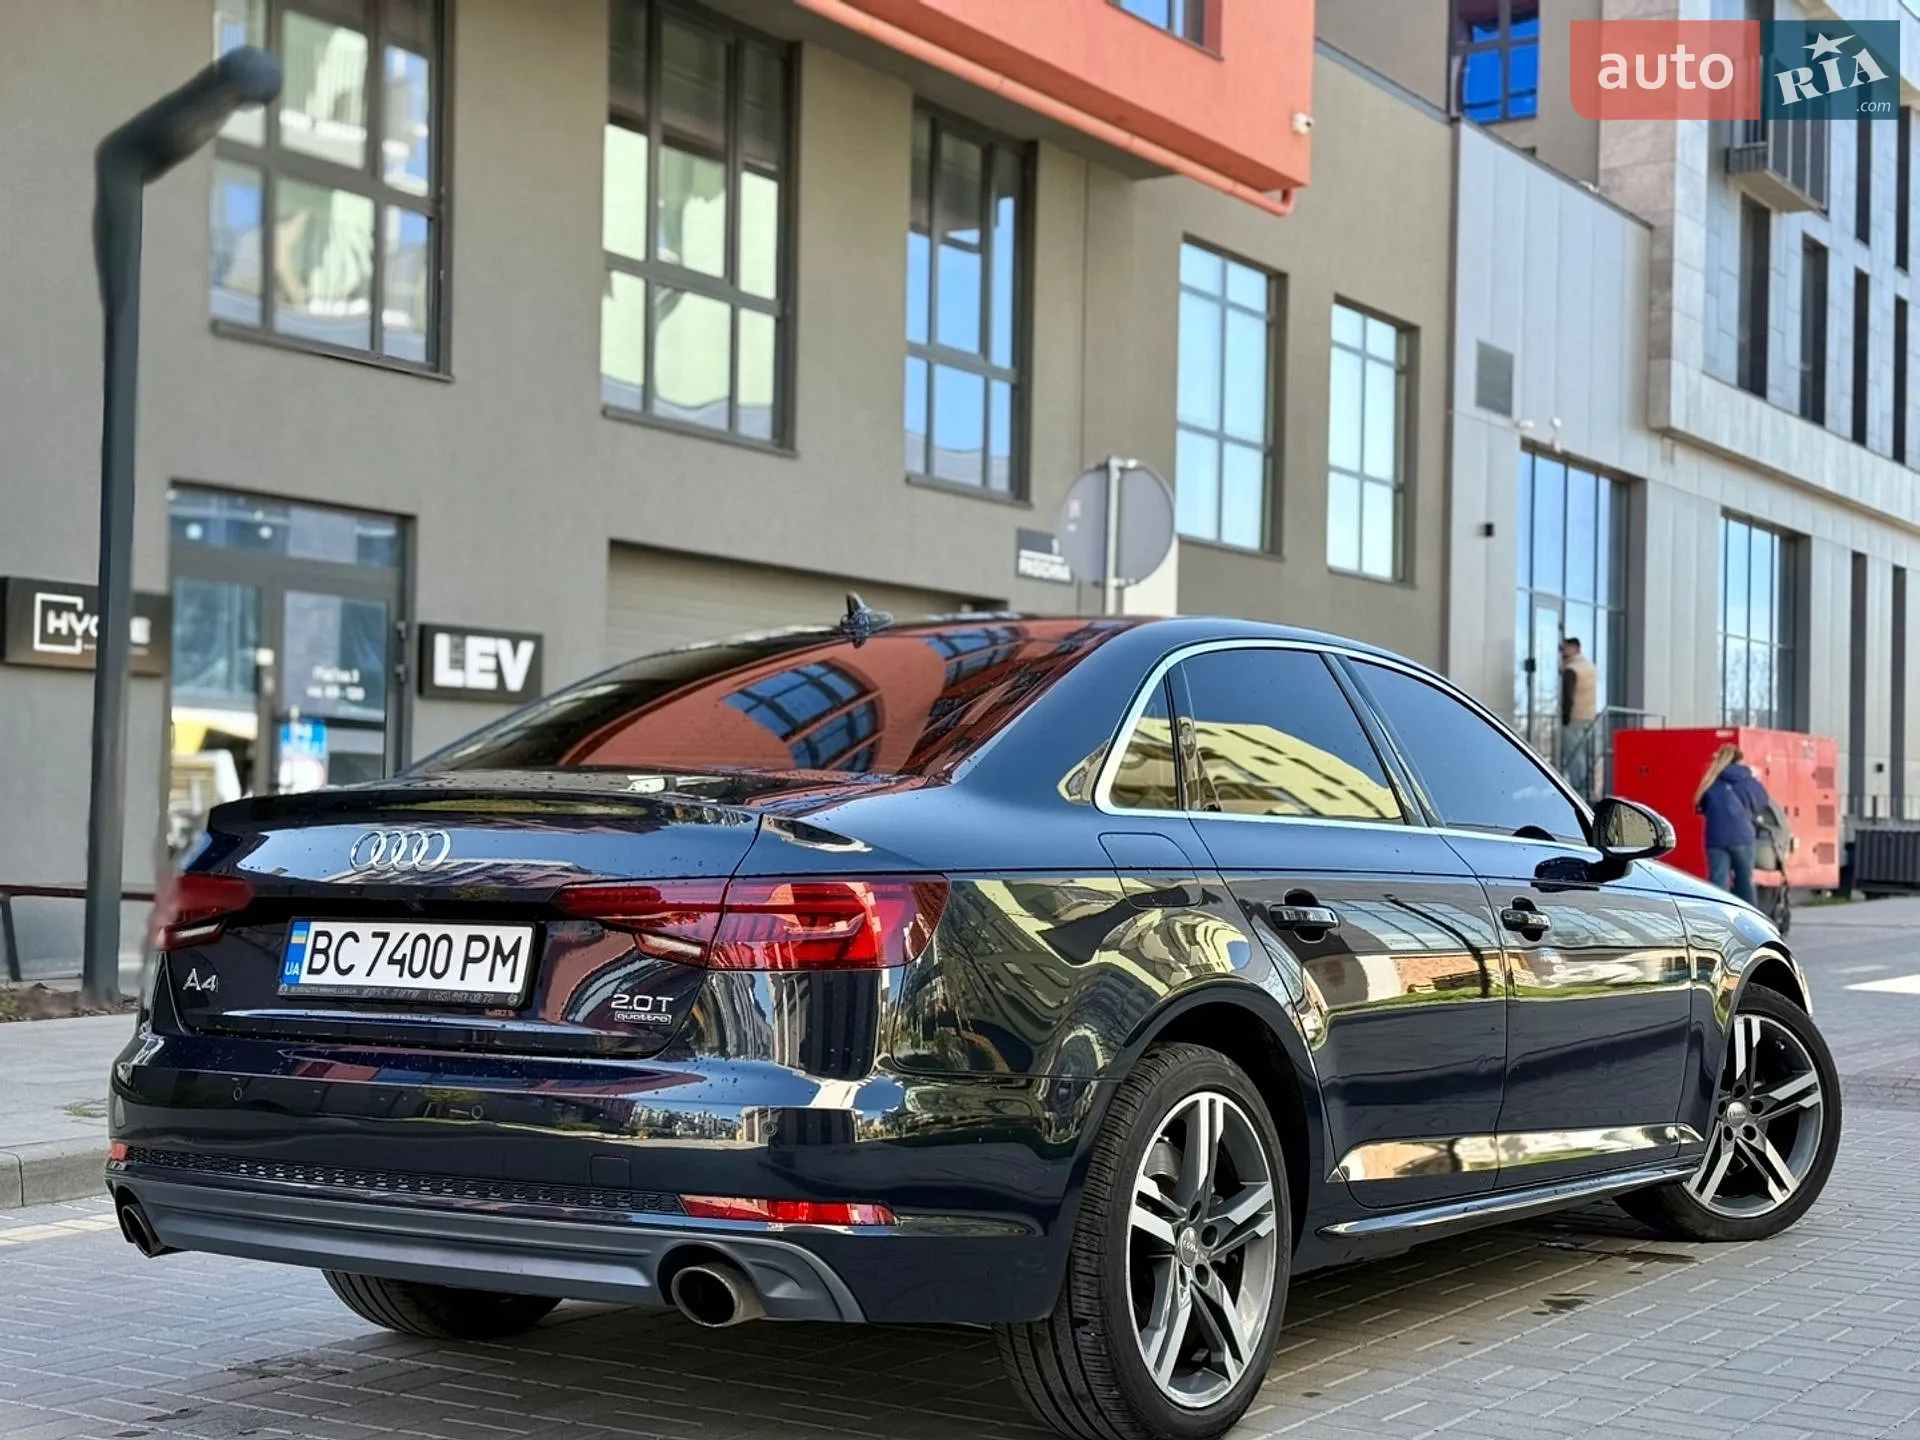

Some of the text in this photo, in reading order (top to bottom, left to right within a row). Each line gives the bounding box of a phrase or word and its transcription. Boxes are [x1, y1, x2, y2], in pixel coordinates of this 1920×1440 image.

[433, 632, 535, 692] LEV
[307, 930, 522, 983] BC 7400 PM
[182, 967, 217, 992] A4
[285, 962, 300, 976] UA
[611, 994, 674, 1012] 2.0T
[617, 1012, 668, 1023] quattro
